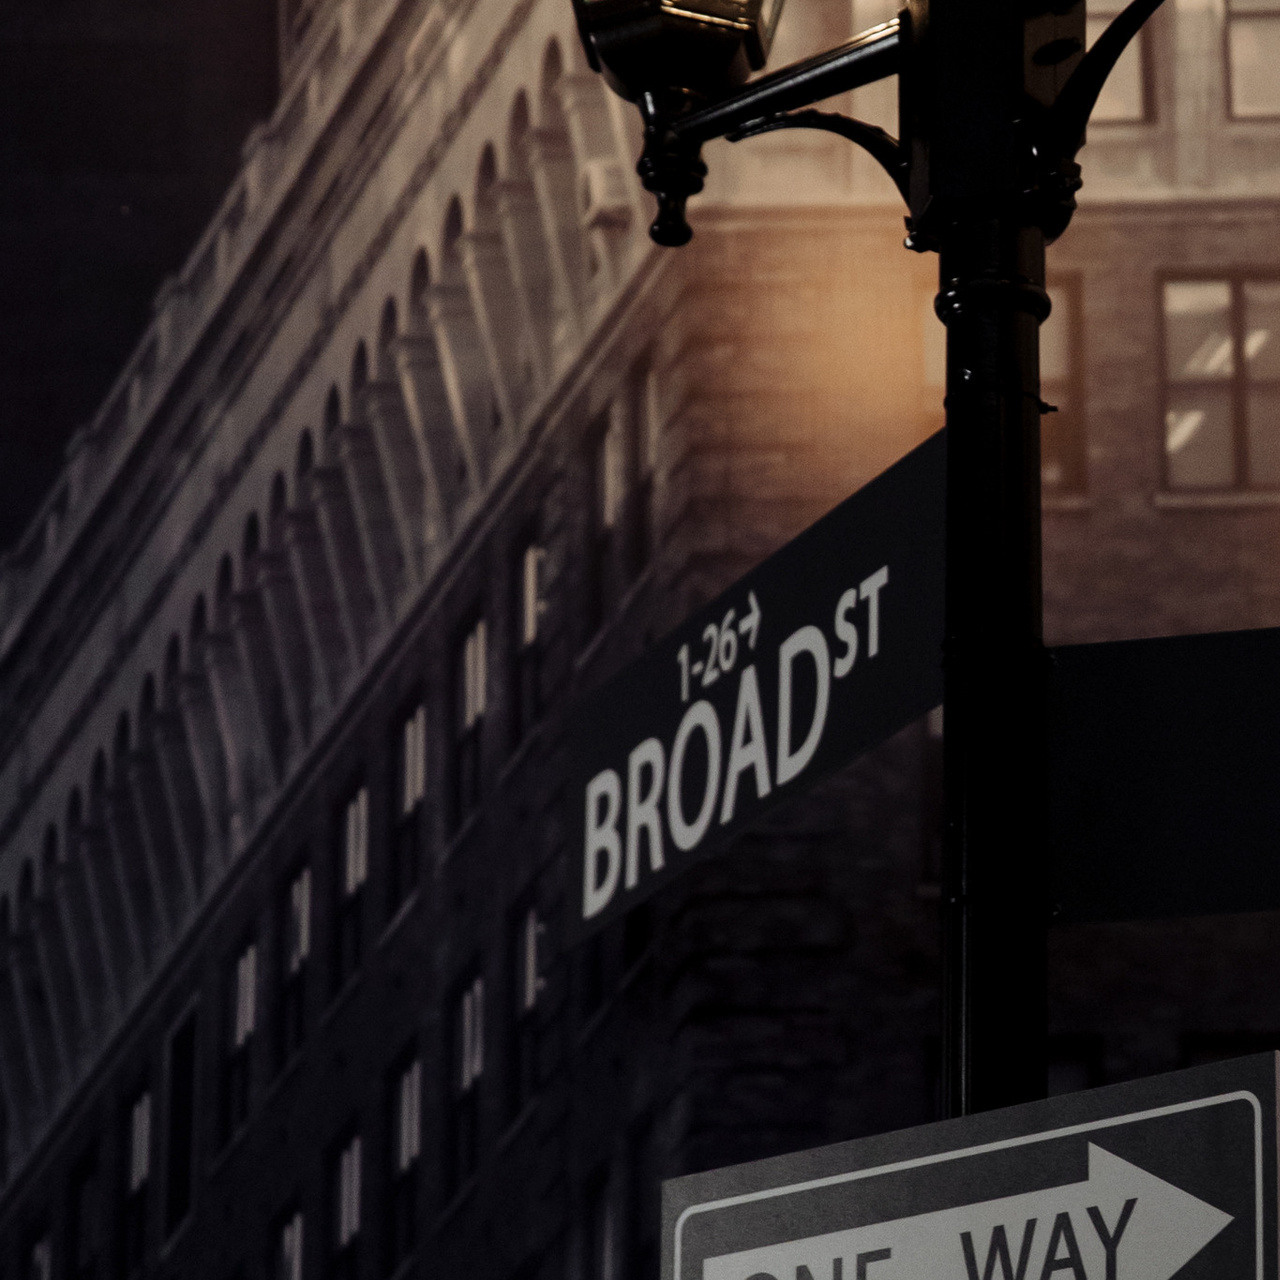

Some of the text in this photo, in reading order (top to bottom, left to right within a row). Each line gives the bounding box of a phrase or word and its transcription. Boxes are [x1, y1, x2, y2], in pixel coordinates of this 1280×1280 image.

[583, 565, 889, 919] BROAD ST
[676, 609, 738, 701] 1-26
